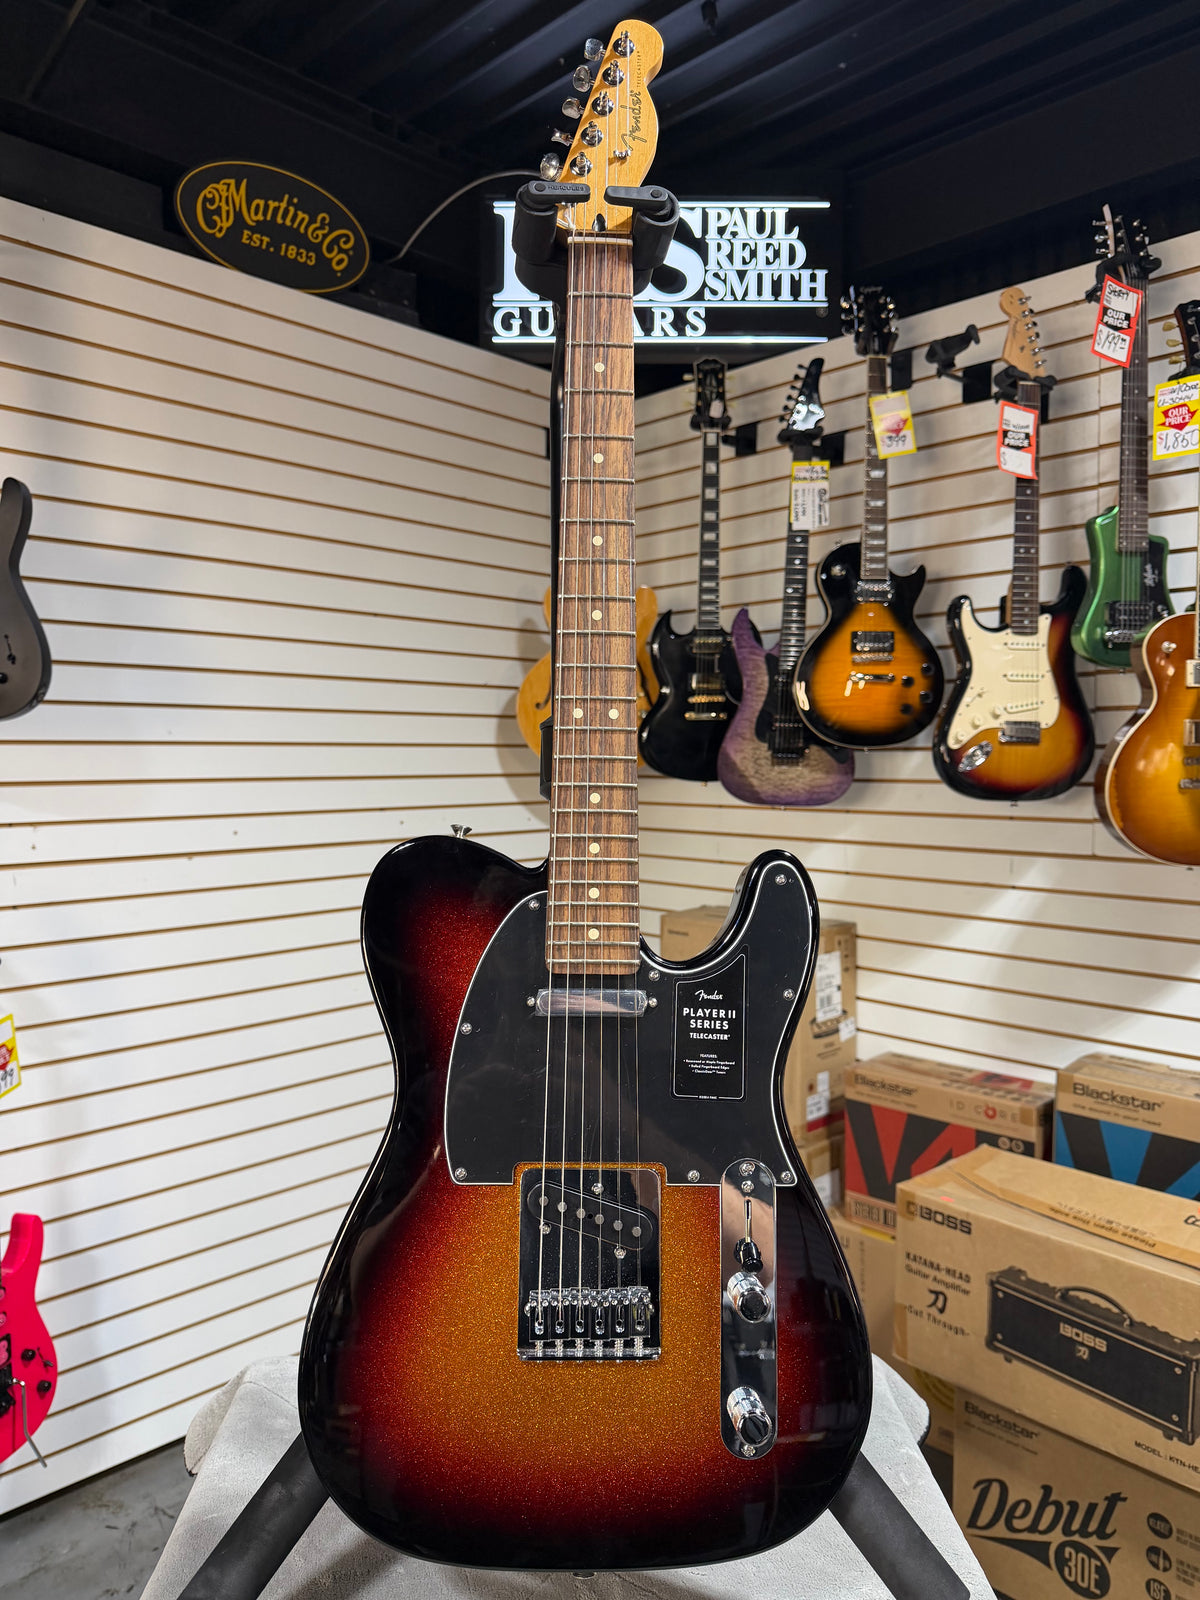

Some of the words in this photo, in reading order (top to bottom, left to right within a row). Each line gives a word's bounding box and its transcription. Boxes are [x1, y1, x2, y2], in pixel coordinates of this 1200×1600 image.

[620, 90, 648, 151] Fender
[705, 207, 800, 240] PAUL
[241, 229, 275, 252] EST.
[280, 243, 316, 266] 1833
[705, 239, 807, 271] REED
[704, 269, 829, 302] SMITH
[493, 307, 707, 337] GURS
[1103, 315, 1130, 328] PRICE
[1107, 309, 1126, 320] OUR
[1165, 413, 1192, 426] PRICE
[1168, 406, 1189, 418] OUR
[694, 989, 723, 1001] Fender
[683, 1007, 726, 1018] PLAYER
[728, 1010, 736, 1019] II
[689, 1019, 729, 1030] SERIES
[689, 1032, 731, 1040] TELECASTER
[853, 1073, 918, 1097] Blackstar
[1072, 1082, 1164, 1112] Blackstar
[920, 1205, 972, 1235] BOSS
[905, 1263, 930, 1280] Guitar
[932, 1275, 971, 1296] Amplifier
[1059, 1321, 1108, 1353] BOSS
[964, 1400, 1039, 1440] Blackstar
[1134, 1440, 1163, 1459] MODEL
[1169, 1455, 1200, 1474] KTN-HE
[966, 1478, 1129, 1540] Debut
[1064, 1543, 1101, 1595] 30E
